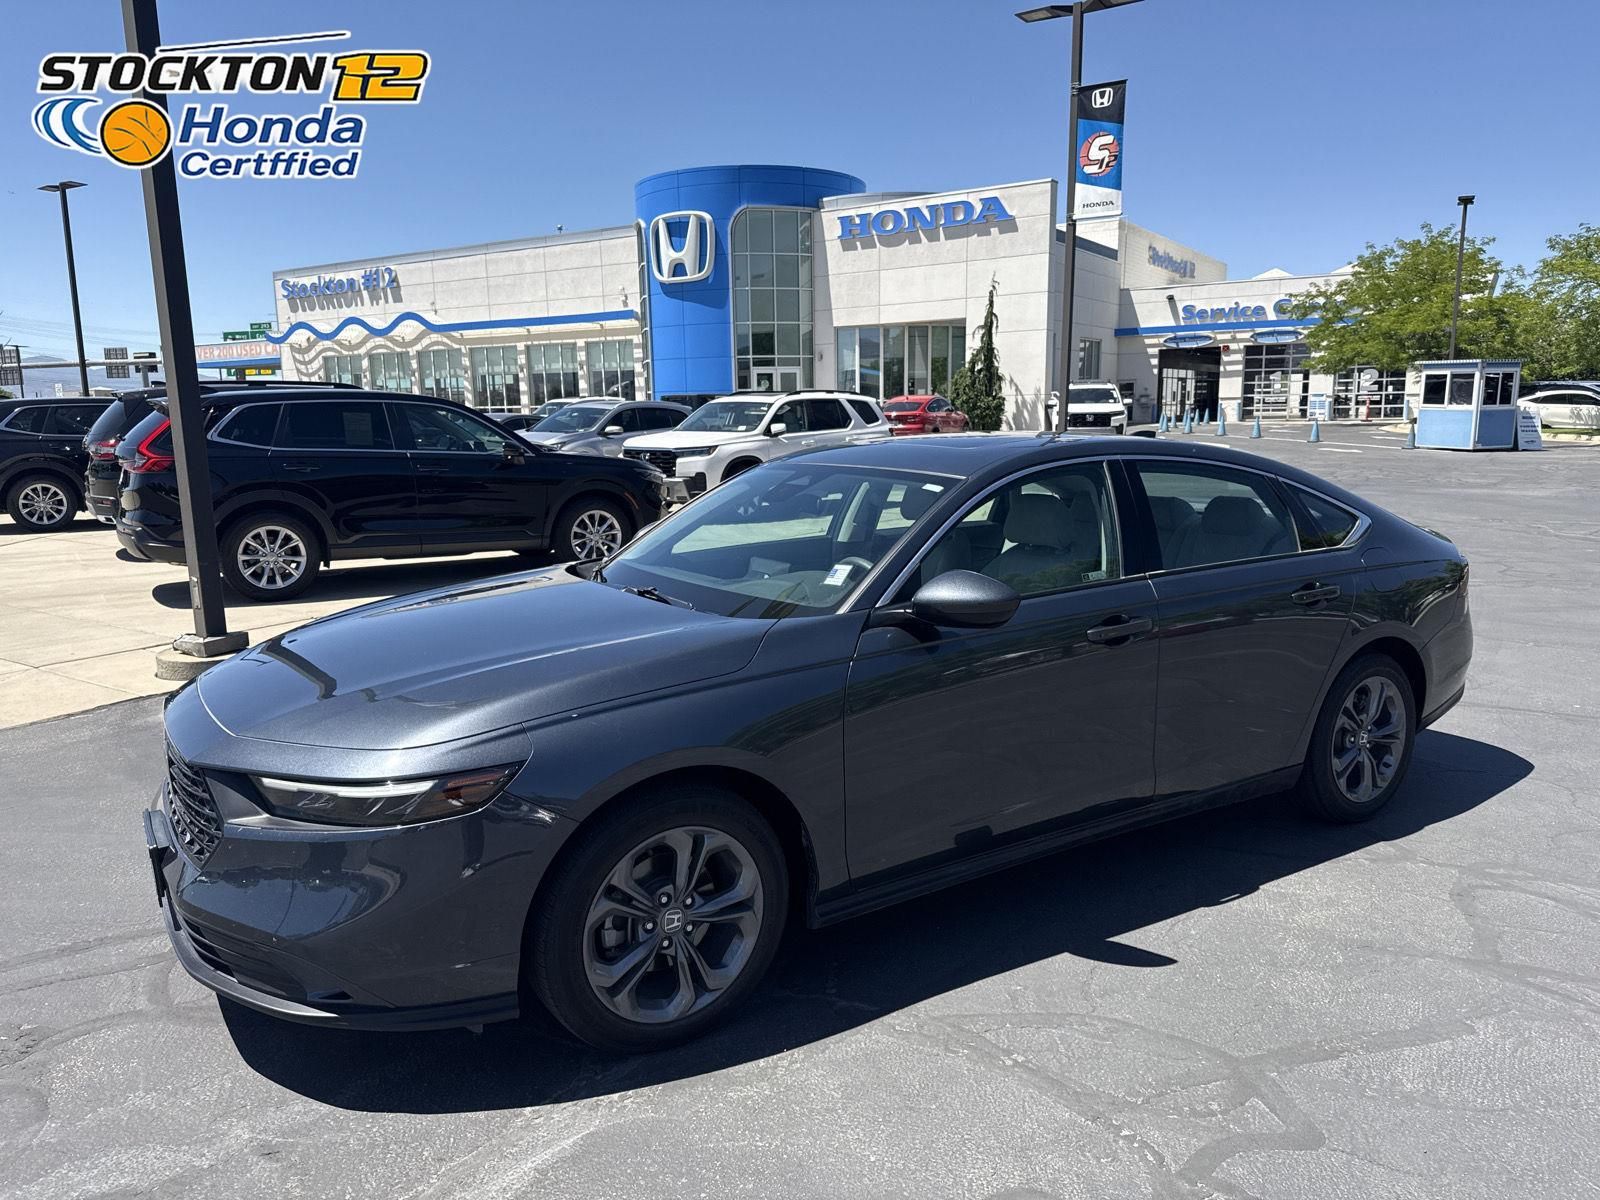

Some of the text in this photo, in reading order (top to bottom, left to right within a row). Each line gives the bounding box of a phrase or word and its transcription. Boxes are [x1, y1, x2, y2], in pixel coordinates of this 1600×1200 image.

[1082, 200, 1114, 209] HONDA
[837, 196, 1015, 239] HONDA
[281, 267, 396, 299] Stockton #12
[1182, 301, 1266, 321] Service
[196, 346, 215, 359] VER
[237, 343, 262, 357] USED
[264, 342, 280, 355] CA
[1361, 369, 1379, 391] 2
